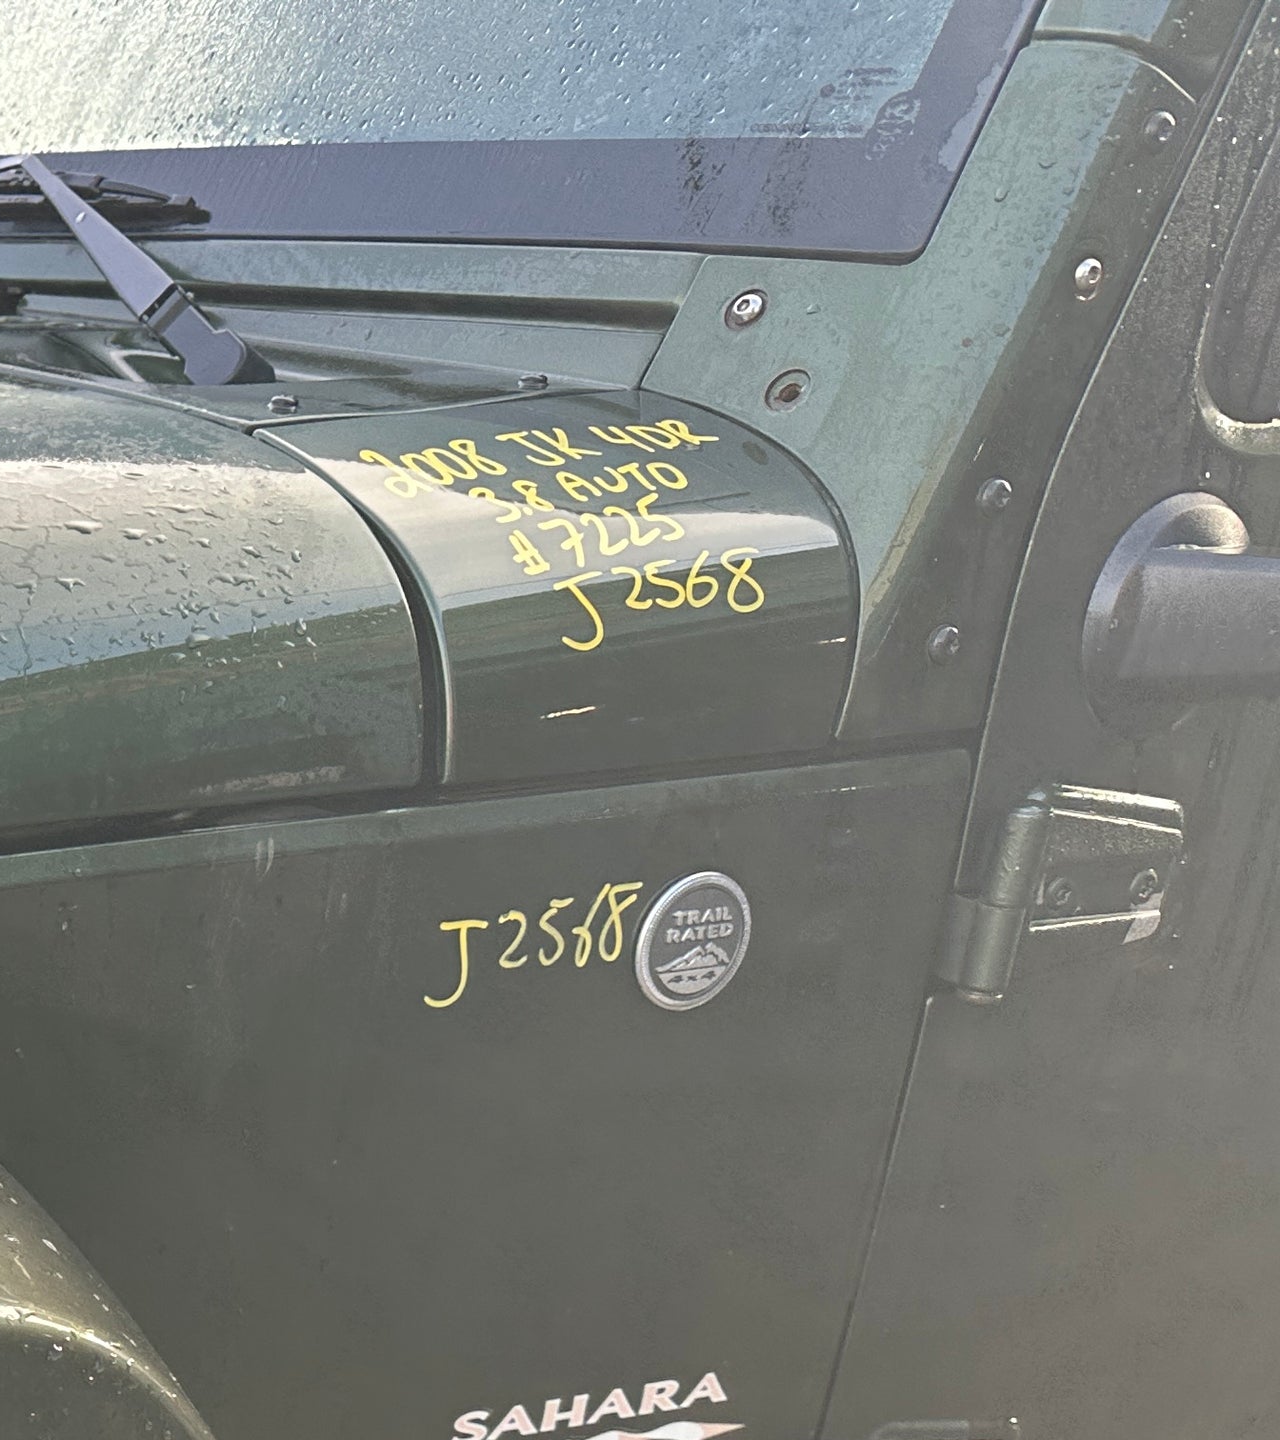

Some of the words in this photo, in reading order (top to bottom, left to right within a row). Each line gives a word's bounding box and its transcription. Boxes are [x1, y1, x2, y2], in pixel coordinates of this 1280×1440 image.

[358, 438, 508, 499] 2008
[496, 426, 602, 467] JK
[588, 418, 720, 453] 4DR
[468, 479, 555, 524] 3.8
[555, 461, 688, 504] AUTO
[553, 547, 766, 652] J2568
[423, 881, 644, 1009] J2568
[666, 921, 734, 945] RATED
[671, 905, 734, 928] TRAIL
